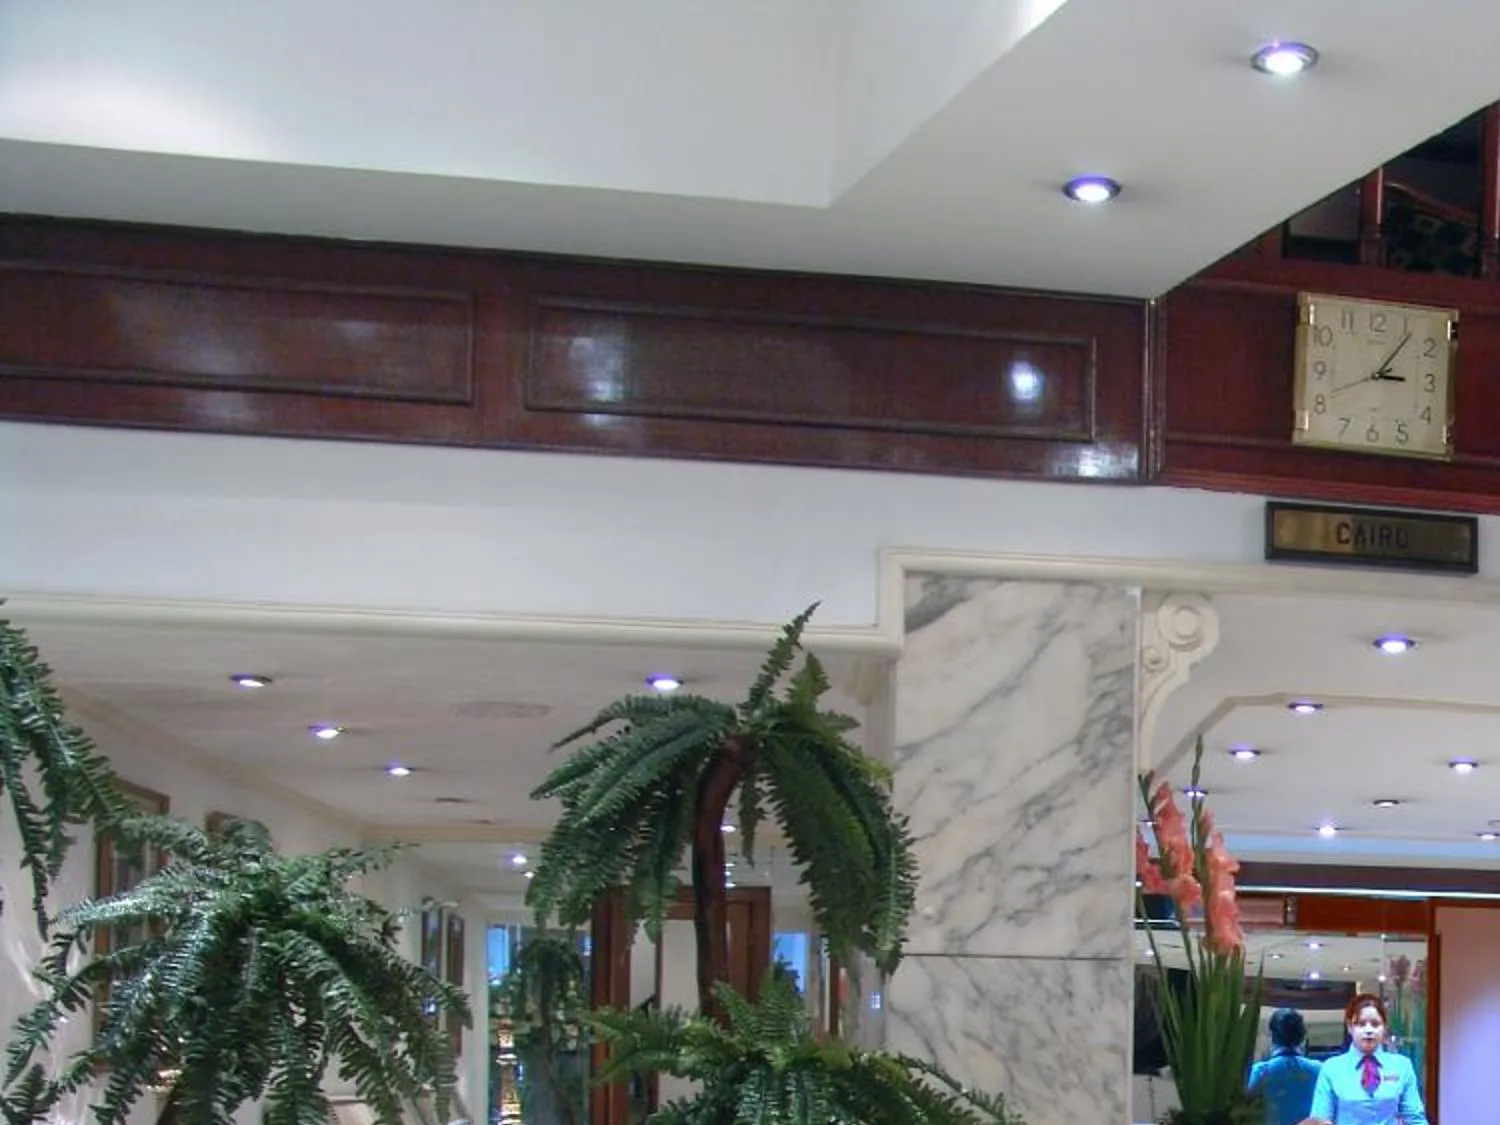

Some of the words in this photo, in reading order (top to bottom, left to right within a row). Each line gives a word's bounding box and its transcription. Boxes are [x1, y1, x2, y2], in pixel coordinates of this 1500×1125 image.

[1340, 309, 1355, 333] 11
[1369, 310, 1386, 333] 12
[1313, 325, 1333, 347] 10
[1423, 337, 1437, 358] 2
[1313, 360, 1327, 380] 9
[1424, 373, 1436, 393] 3
[1313, 394, 1327, 414] 8
[1420, 405, 1432, 425] 4
[1337, 417, 1350, 436] 7
[1366, 424, 1379, 443] 6
[1395, 423, 1409, 443] 5
[1336, 521, 1408, 548] CAIRO
